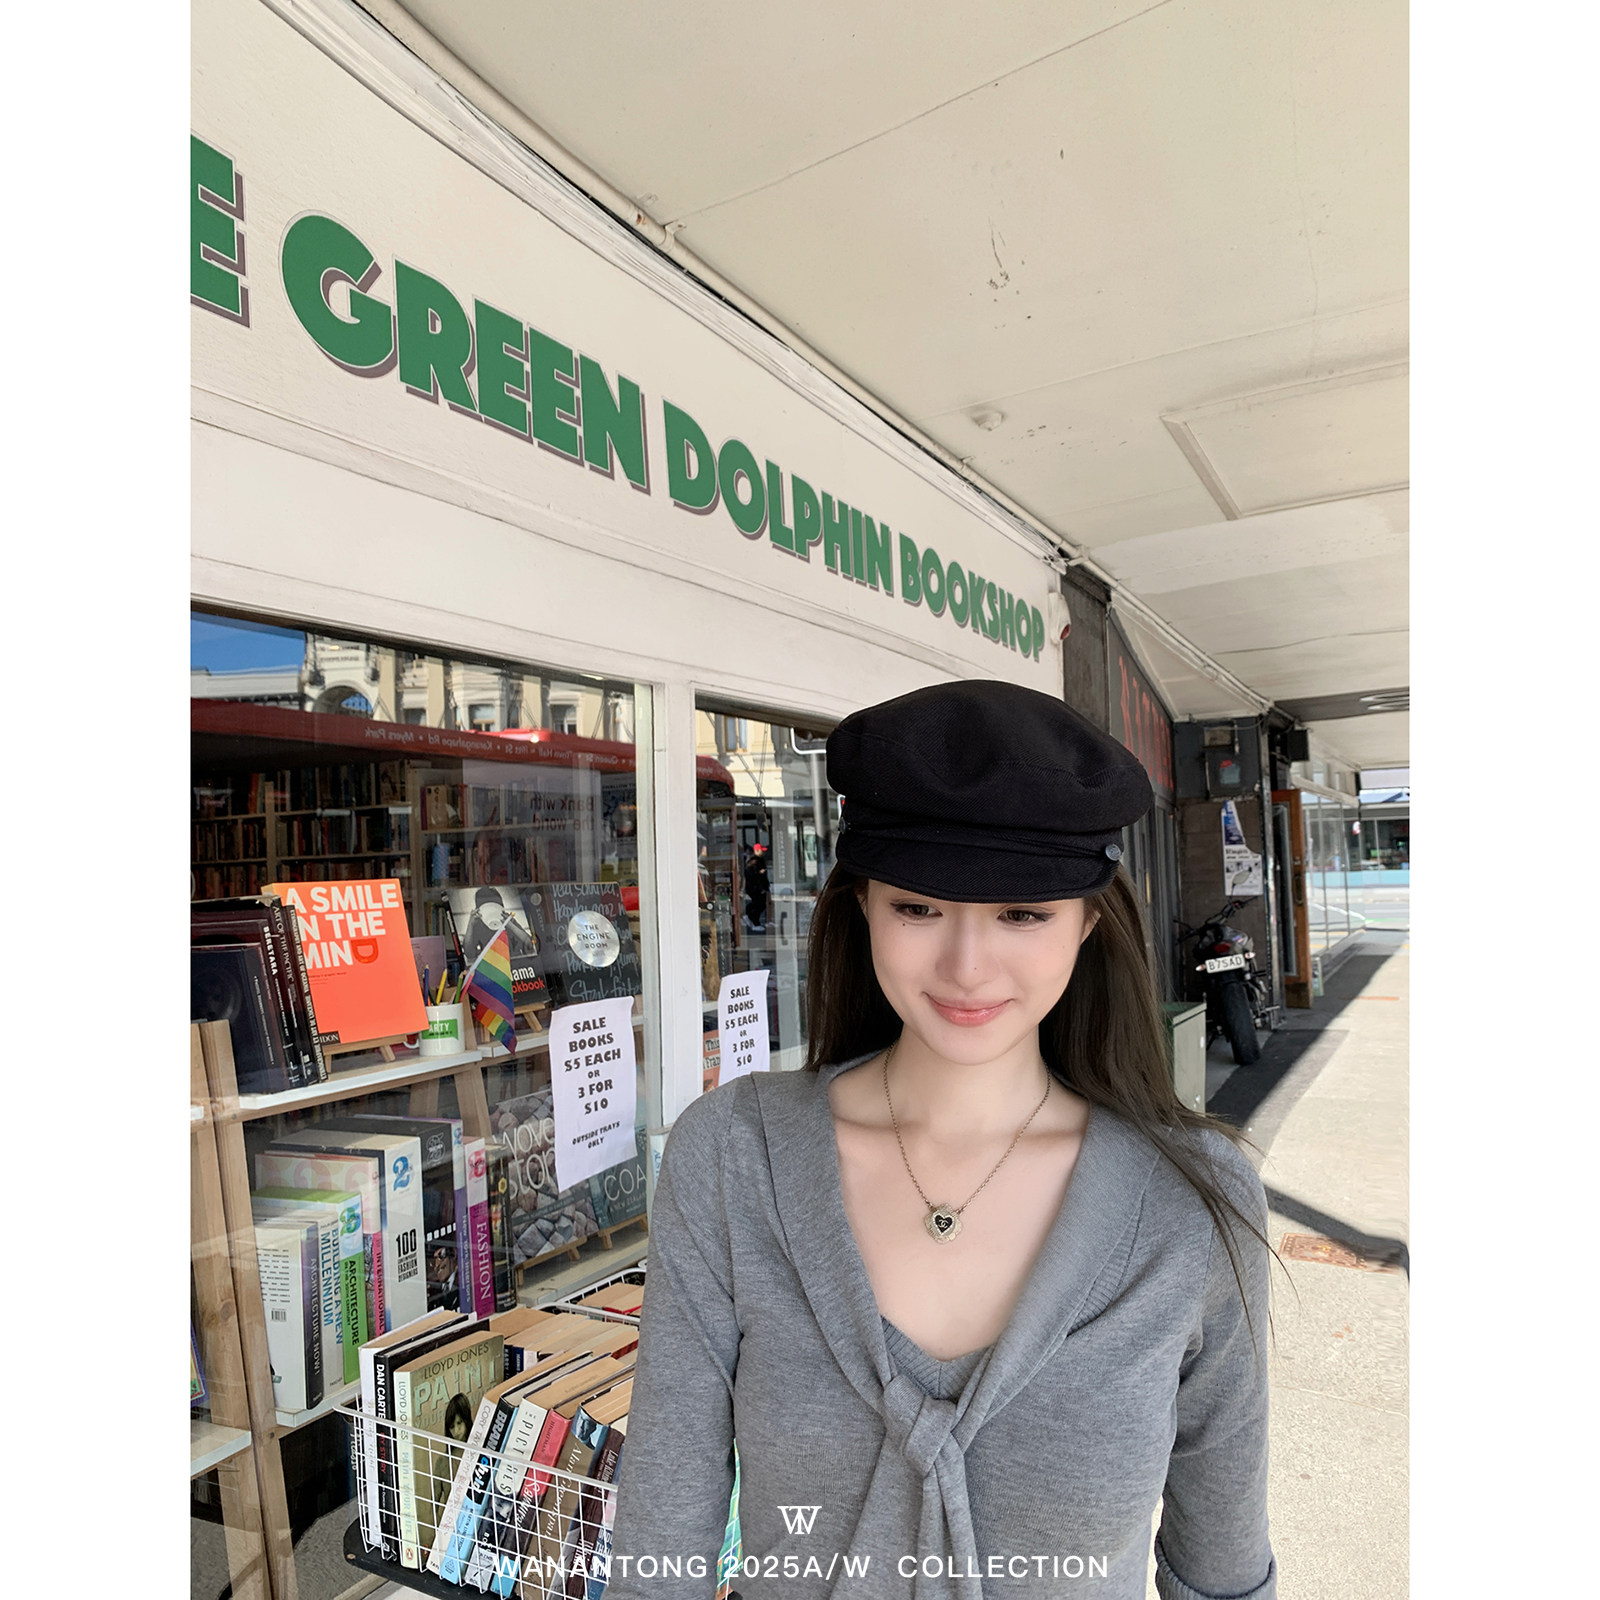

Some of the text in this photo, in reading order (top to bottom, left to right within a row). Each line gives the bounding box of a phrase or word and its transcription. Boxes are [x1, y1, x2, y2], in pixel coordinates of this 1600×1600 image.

[279, 209, 651, 496] GREEN
[663, 397, 893, 599] DOLPHIN
[899, 531, 1045, 662] BOOKSHOP
[285, 884, 399, 914] A SMILE
[272, 906, 282, 922] ART
[325, 911, 386, 939] THE
[262, 926, 279, 975] BERETARA
[279, 935, 288, 951] THE
[576, 932, 610, 941] ENGINE
[282, 952, 295, 982] PACIFIC
[510, 964, 535, 982] ama
[511, 980, 545, 995] okbook
[730, 986, 750, 999] SALE
[727, 1000, 754, 1015] BOOKS
[738, 1013, 759, 1027] EACH
[573, 1017, 607, 1034] SALE
[568, 1032, 614, 1053] BOOKS
[732, 1038, 755, 1053] 3 FOR
[585, 1048, 621, 1068] EACH
[588, 1069, 600, 1079] OR
[578, 1079, 613, 1099] 3 FOR
[492, 1117, 555, 1157] Wove
[572, 1121, 621, 1146] OUTSIDE TRAYS
[588, 1136, 604, 1150] ONLY
[604, 1164, 648, 1201] COA
[395, 1228, 417, 1258] 100
[398, 1257, 418, 1275] FASHION
[477, 1222, 490, 1300] FASHION
[320, 1232, 333, 1326] MILLENNIUM
[331, 1229, 343, 1345] BUILDING A NEW
[375, 1252, 385, 1330] INTERNATIONAL
[310, 1259, 320, 1340] ARCHITECTURE
[348, 1260, 359, 1345] ARCHITECTURE
[424, 1357, 454, 1380] LLOYD
[456, 1342, 489, 1367] JONES
[376, 1364, 387, 1421] DAN CARTE
[398, 1381, 408, 1441] LLOYD JOES
[477, 1405, 492, 1428] CORY
[484, 1410, 509, 1452] BRAN
[497, 1419, 536, 1494] PICTRES
[539, 1443, 585, 1540] Alan Greenspan
